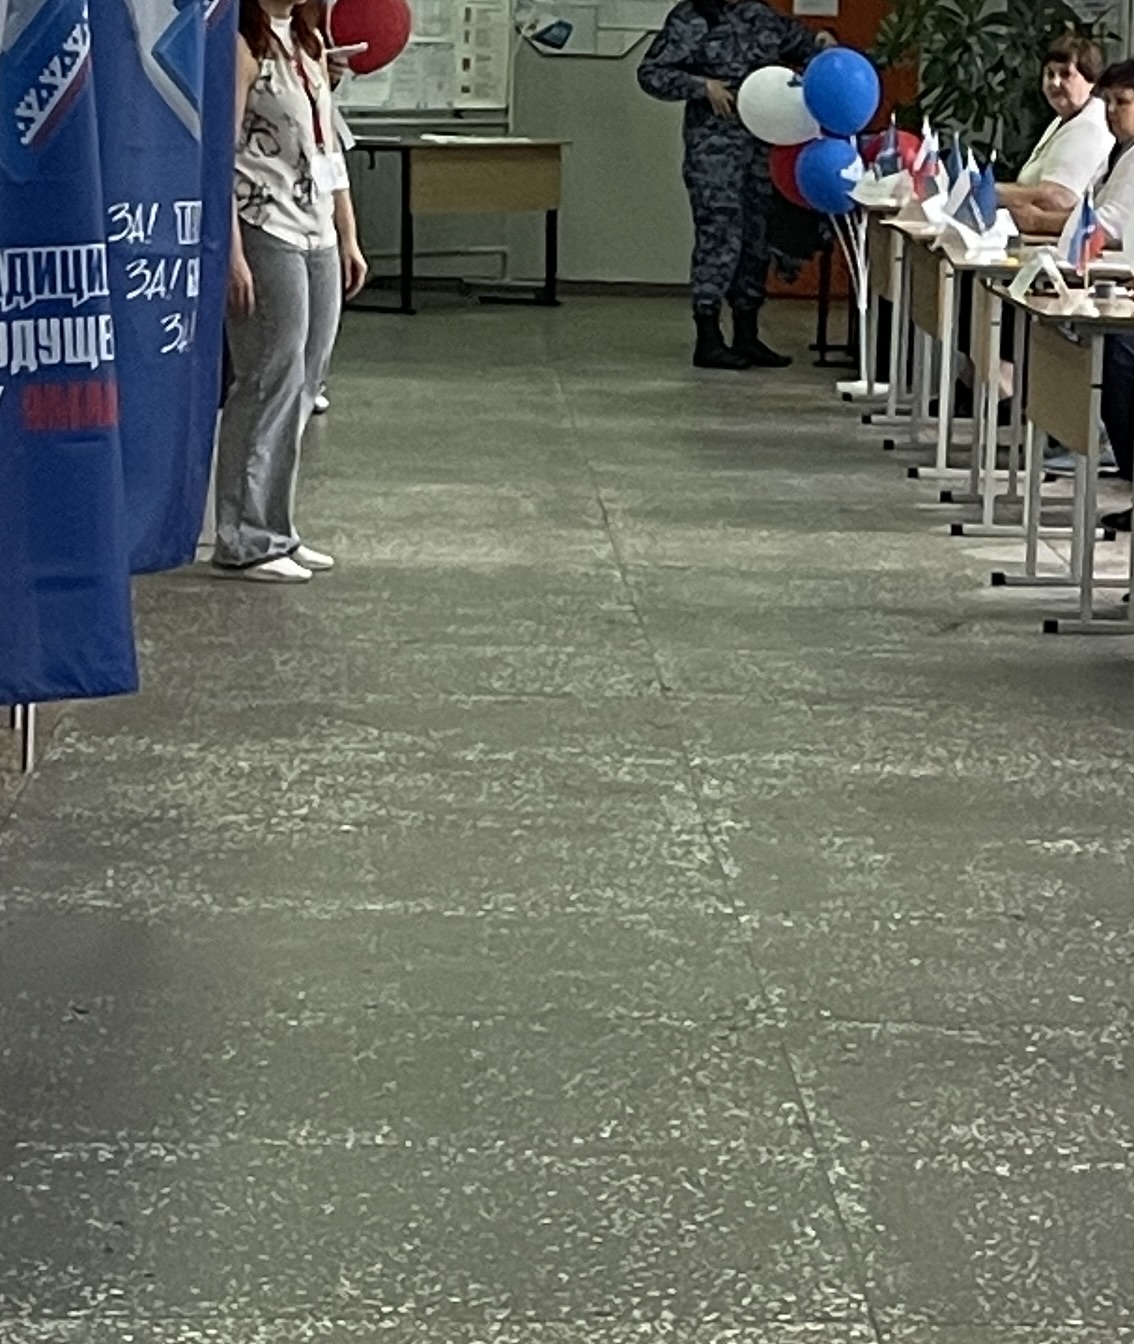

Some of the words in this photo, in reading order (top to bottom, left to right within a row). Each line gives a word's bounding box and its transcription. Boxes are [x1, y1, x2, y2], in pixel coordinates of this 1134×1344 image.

[108, 202, 159, 244] ЗА!
[0, 242, 110, 312] ДИЦИ
[126, 258, 182, 301] ЗА!
